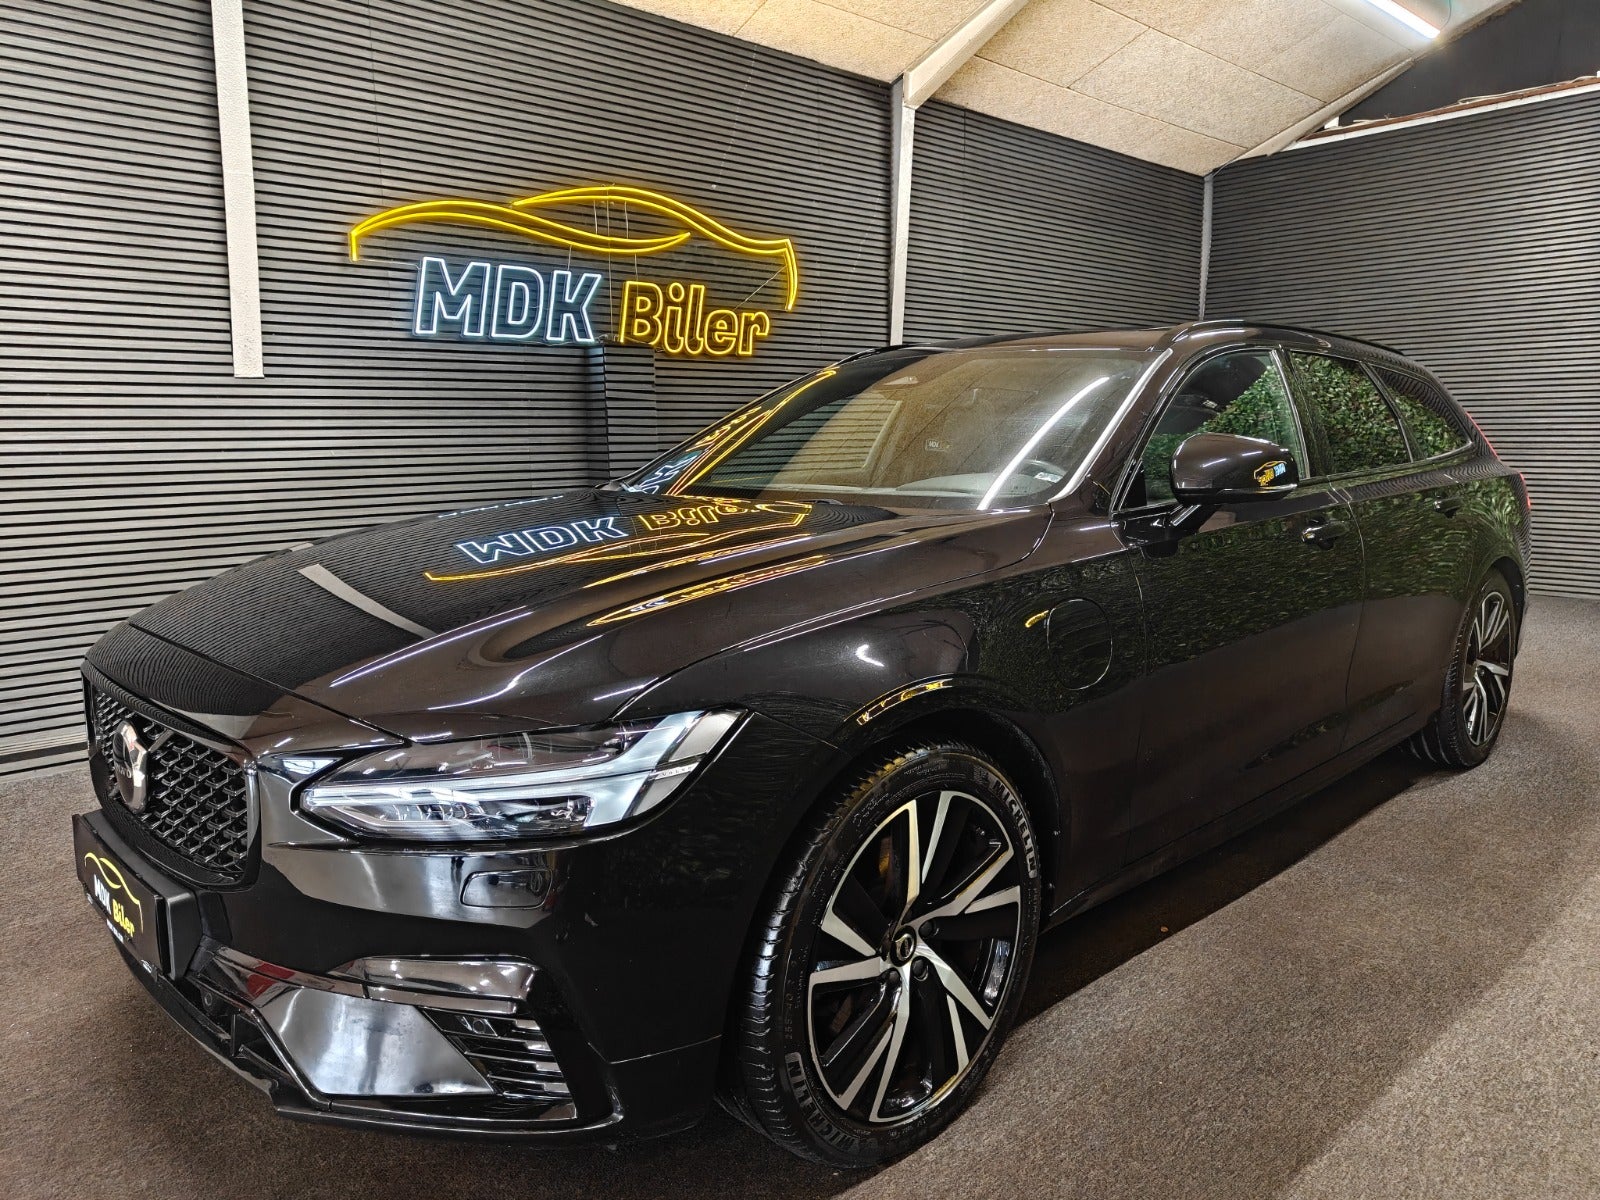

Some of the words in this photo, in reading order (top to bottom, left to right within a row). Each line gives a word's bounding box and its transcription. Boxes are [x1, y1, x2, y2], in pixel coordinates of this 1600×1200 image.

[414, 256, 602, 343] MDK
[619, 280, 770, 356] Biler
[94, 873, 111, 914] MDK
[112, 899, 135, 938] Biler
